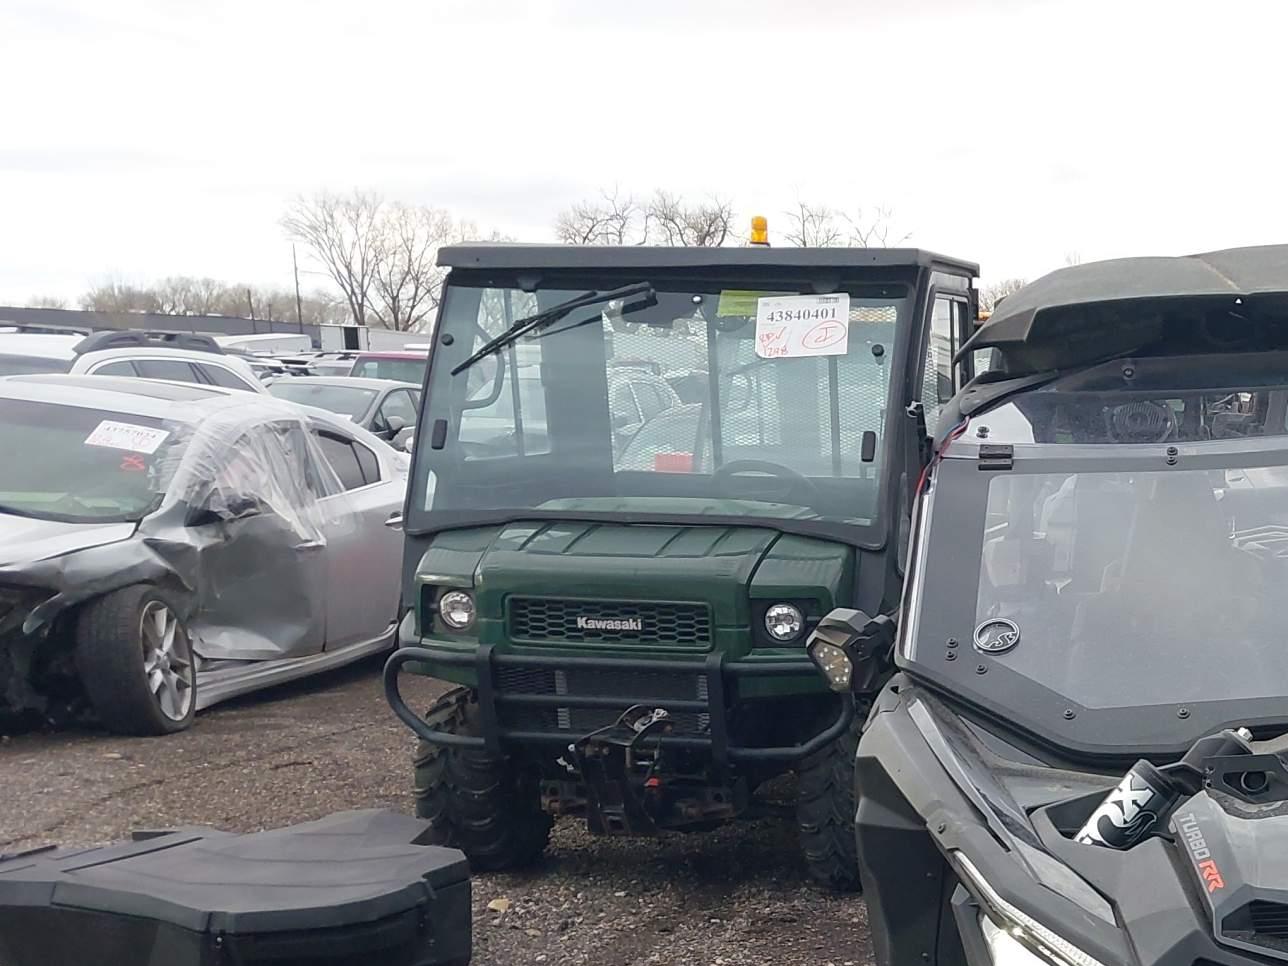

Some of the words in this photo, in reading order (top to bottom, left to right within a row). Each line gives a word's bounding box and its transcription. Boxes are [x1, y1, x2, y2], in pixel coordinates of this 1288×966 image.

[766, 307, 836, 323] 43840401
[576, 616, 642, 631] Kawasaki
[1179, 812, 1211, 860] TURBO
